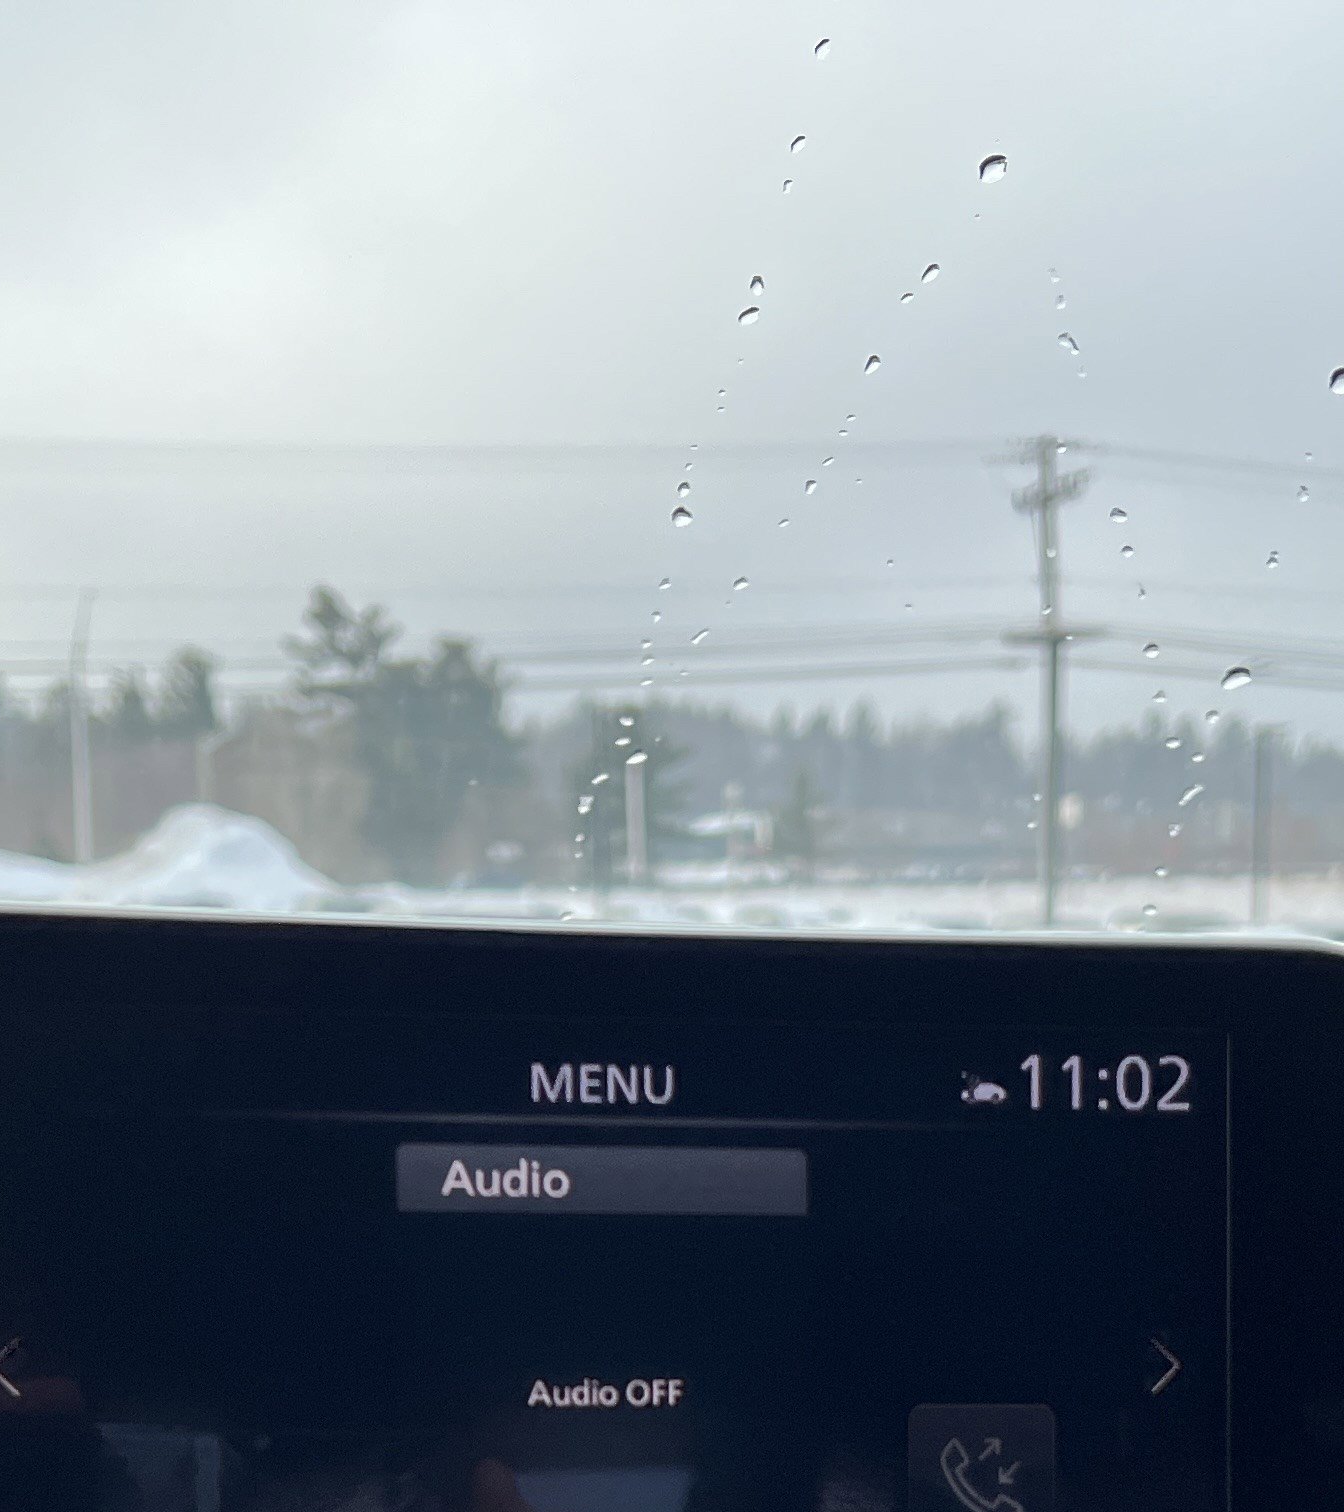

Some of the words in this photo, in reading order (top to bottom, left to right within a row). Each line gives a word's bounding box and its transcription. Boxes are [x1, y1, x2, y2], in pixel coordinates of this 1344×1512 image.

[530, 1063, 675, 1104] MENU
[1021, 1055, 1191, 1111] 11:02
[441, 1158, 570, 1198] Audio
[527, 1377, 617, 1406] Audio
[626, 1379, 684, 1406] OFF
